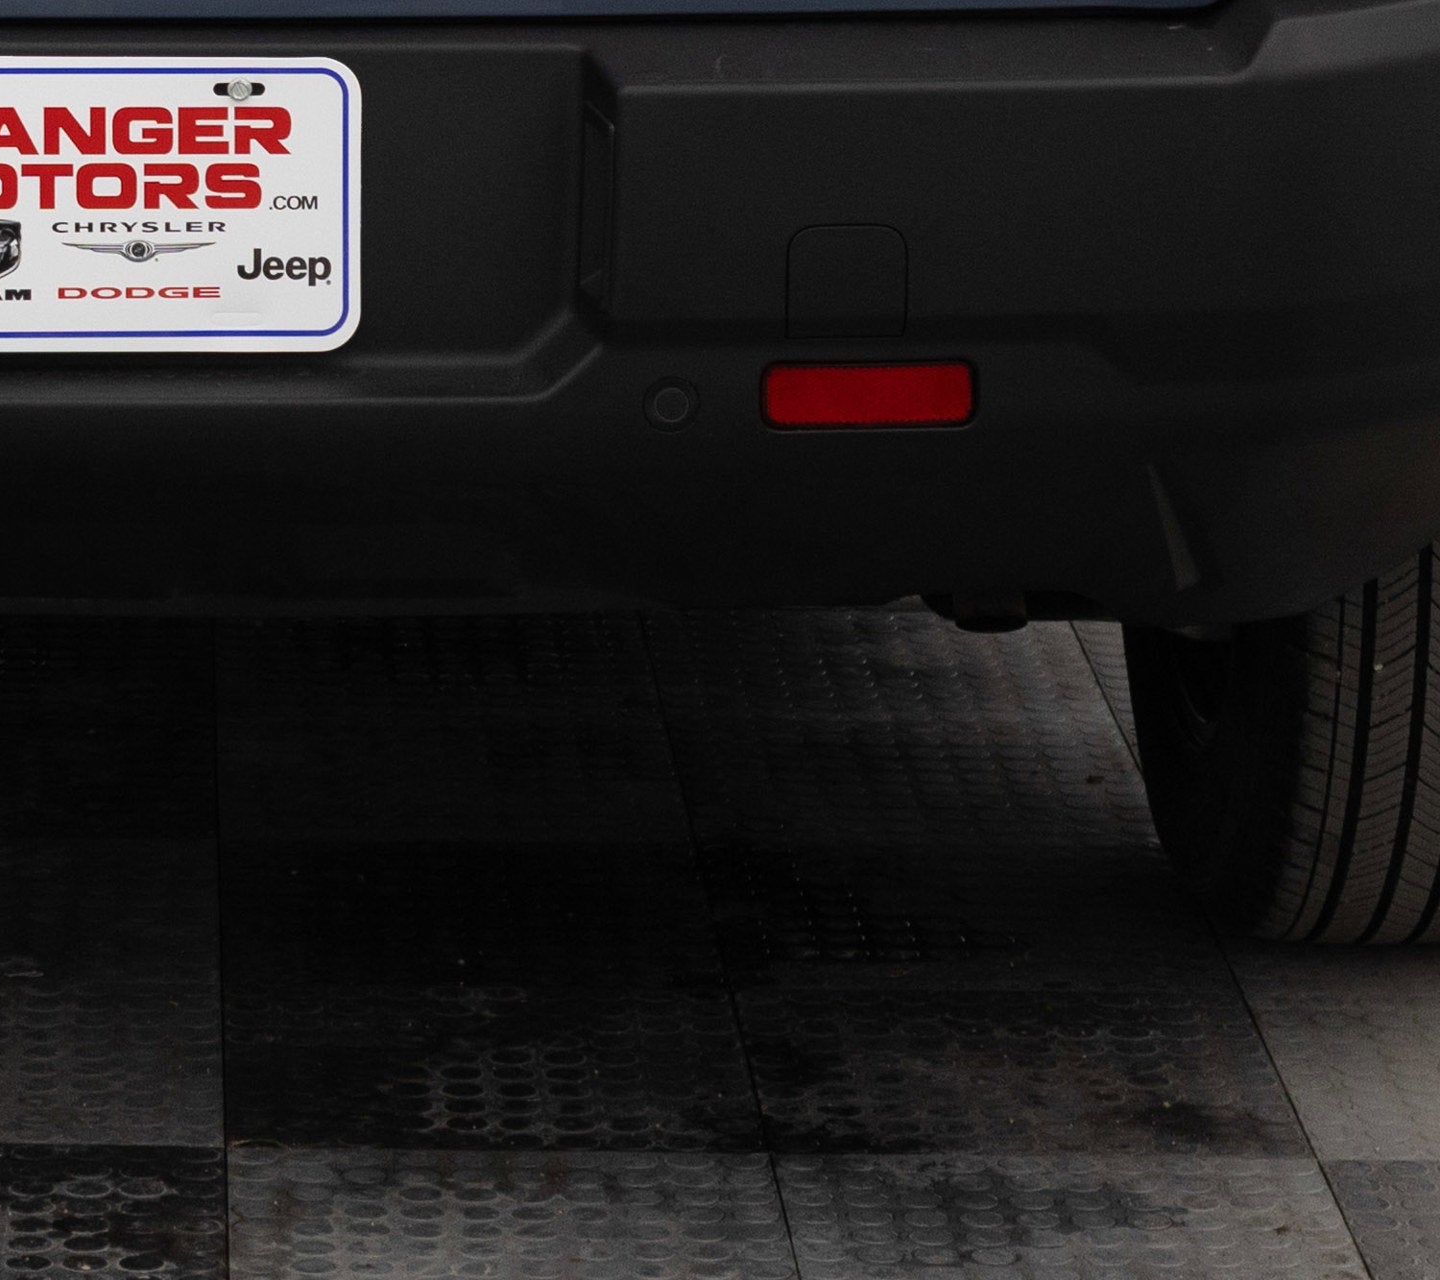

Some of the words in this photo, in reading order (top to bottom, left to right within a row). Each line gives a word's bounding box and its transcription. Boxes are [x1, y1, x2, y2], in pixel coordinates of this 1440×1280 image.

[51, 221, 226, 234] CHRYSLER
[236, 247, 332, 287] Jeep
[57, 286, 220, 300] DODGE
